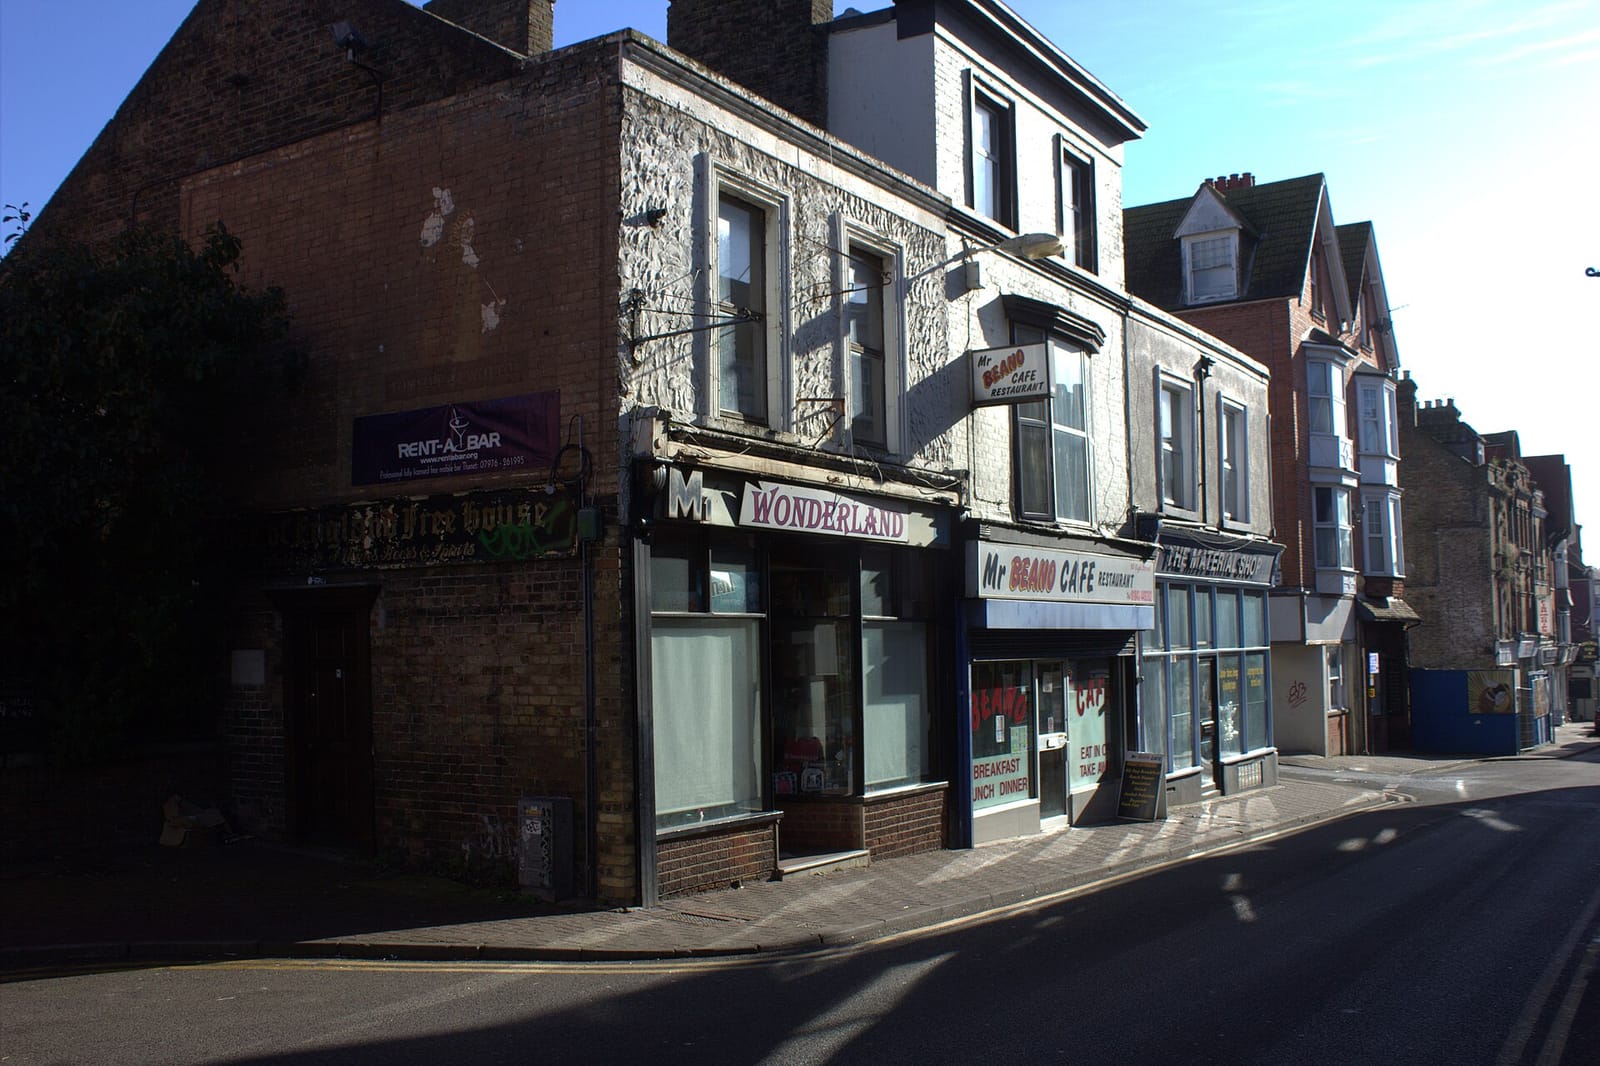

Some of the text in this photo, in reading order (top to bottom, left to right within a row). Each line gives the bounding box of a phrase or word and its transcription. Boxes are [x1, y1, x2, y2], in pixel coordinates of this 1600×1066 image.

[977, 354, 993, 368] Mr
[982, 348, 1025, 389] BEANO
[1011, 369, 1037, 384] CAFE
[990, 381, 1045, 397] RESTAURANT
[467, 432, 502, 450] BAR
[752, 487, 904, 538] WONDERLAND
[1167, 546, 1190, 568] THE
[1190, 548, 1237, 574] MATERIAL
[1238, 554, 1262, 576] SHOP
[983, 551, 1135, 594] Mr BEANO CAFE RESTAURANT
[972, 684, 1028, 732] BEANO
[1080, 746, 1092, 759] EAT
[1093, 744, 1101, 758] IN
[974, 758, 1020, 780] BREAKFAST
[1080, 763, 1096, 778] TAKE
[999, 777, 1028, 796] DINNER
